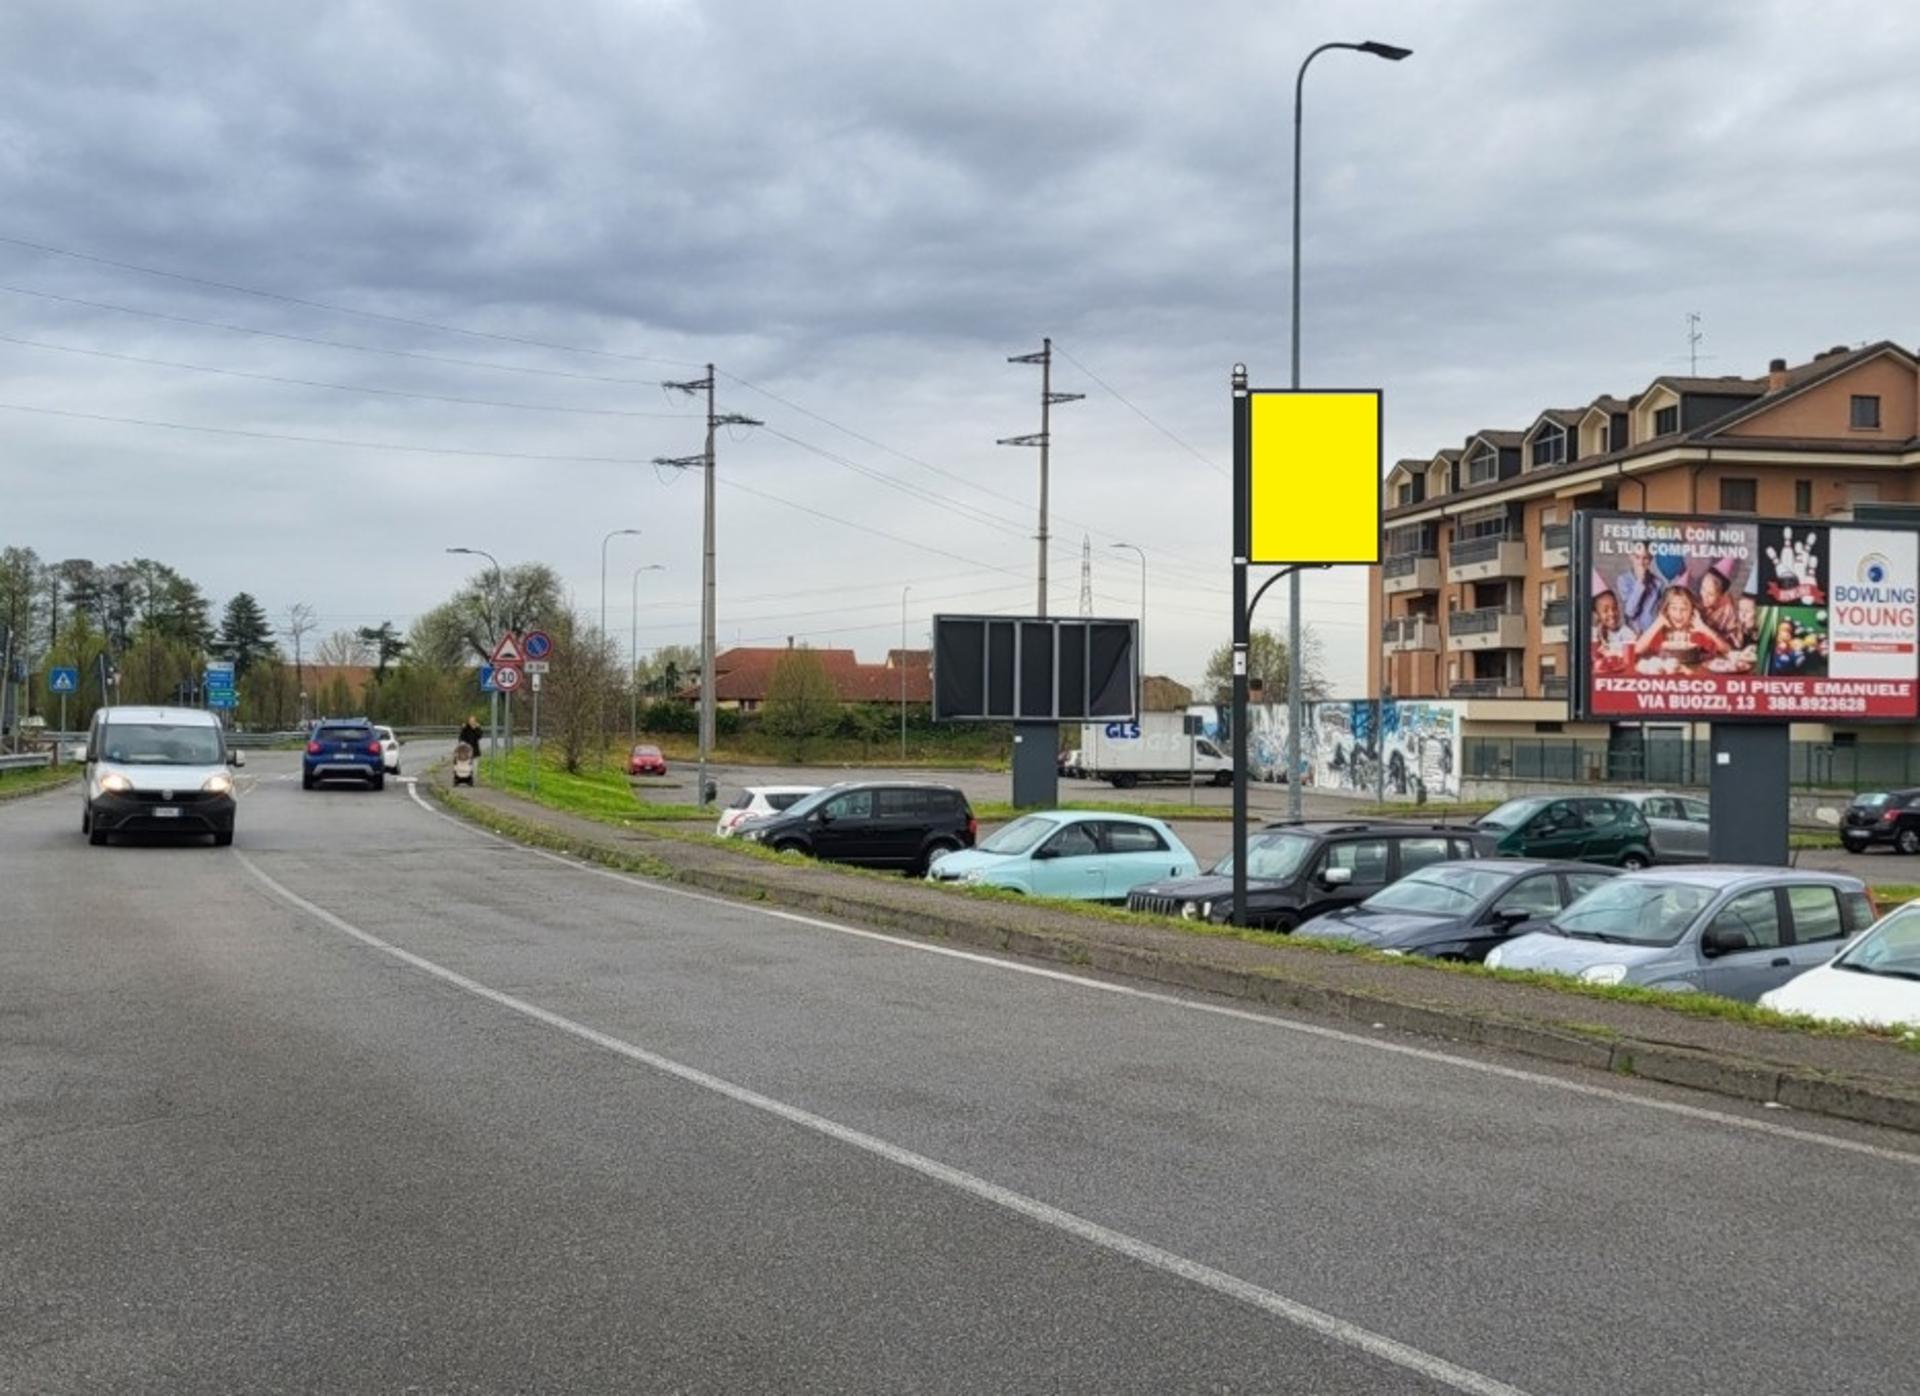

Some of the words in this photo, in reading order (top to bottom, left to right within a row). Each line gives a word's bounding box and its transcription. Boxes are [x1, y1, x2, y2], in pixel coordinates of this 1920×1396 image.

[1603, 524, 1683, 541] FESTEGGIA
[1686, 526, 1716, 542] CON
[1719, 529, 1745, 543] NOI
[1599, 540, 1613, 554] IL
[1617, 541, 1645, 555] TUO
[1648, 542, 1749, 560] COMPLEANNO
[1835, 585, 1915, 604] BOWLING
[1836, 605, 1914, 627] YOUNG
[501, 671, 514, 684] 30
[1594, 677, 1718, 693] FIZZONASCO
[1726, 679, 1747, 694] DI
[1751, 680, 1805, 695] PIEVE
[1813, 681, 1911, 697] EMANUELE
[1637, 694, 1665, 709] VIA
[1669, 695, 1732, 712] BUOZZI,
[1736, 696, 1756, 711] 13
[1105, 722, 1141, 739] GLS
